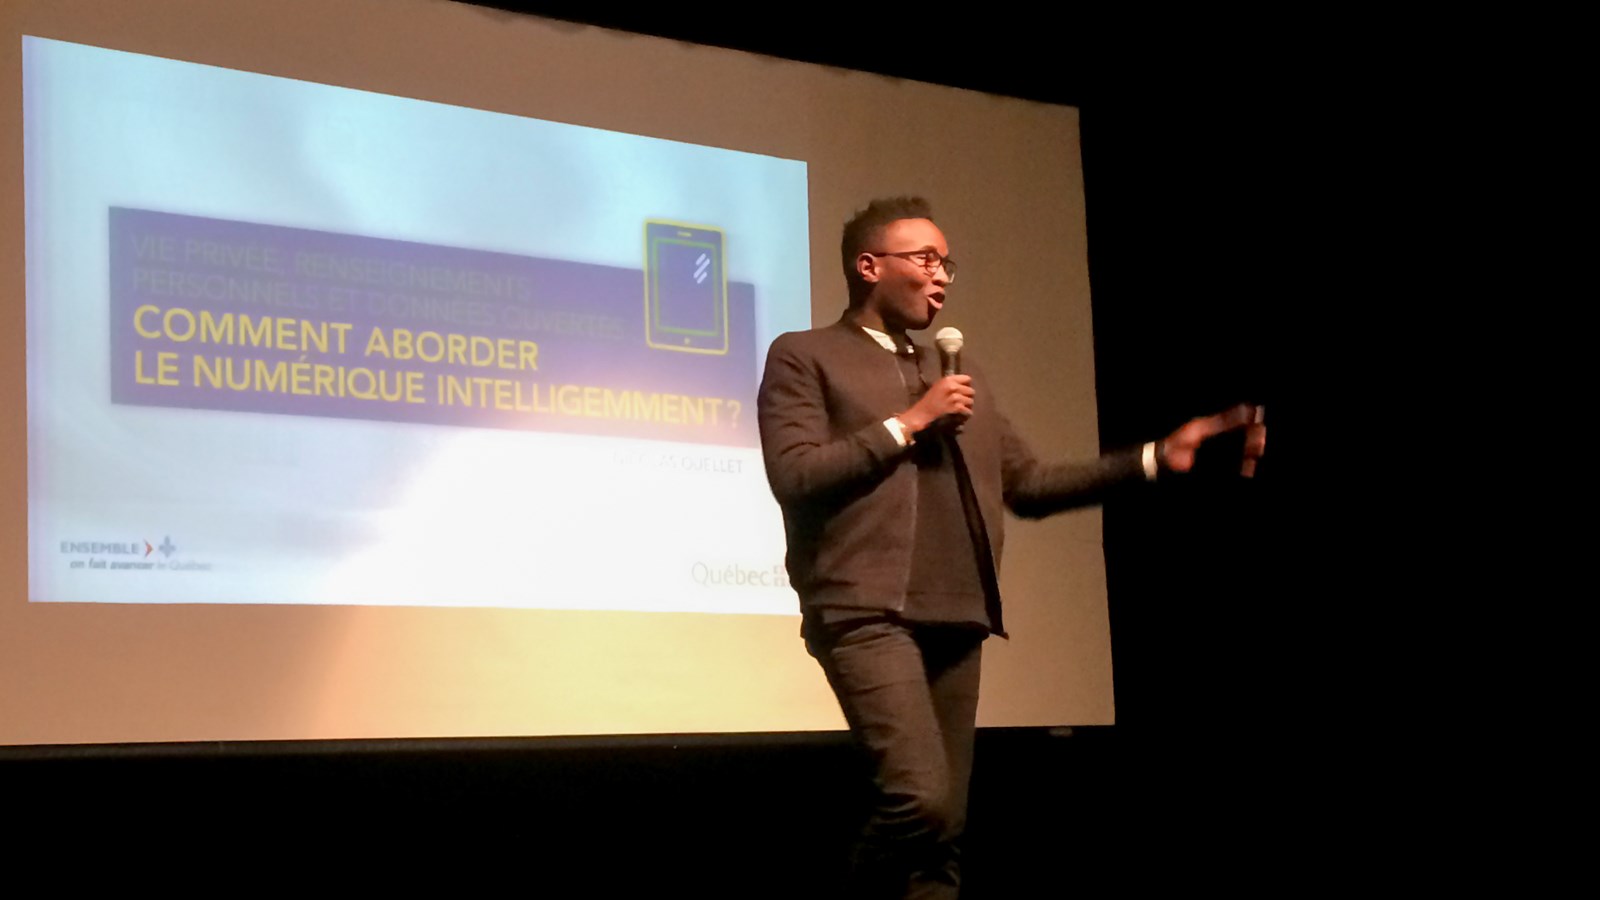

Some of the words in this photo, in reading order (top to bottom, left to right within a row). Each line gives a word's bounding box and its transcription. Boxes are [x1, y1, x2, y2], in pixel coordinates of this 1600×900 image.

[130, 233, 176, 262] VIE
[132, 267, 319, 314] PERSONNELS
[329, 288, 360, 315] ET
[133, 304, 353, 354] COMMENT
[364, 326, 539, 371] ABORDER
[135, 350, 180, 386] LE
[193, 354, 426, 405] NUMÉRIQUE
[60, 541, 140, 555] ENSEMBLE
[70, 560, 85, 569] on
[88, 558, 107, 569] fait
[691, 561, 770, 587] Québec
